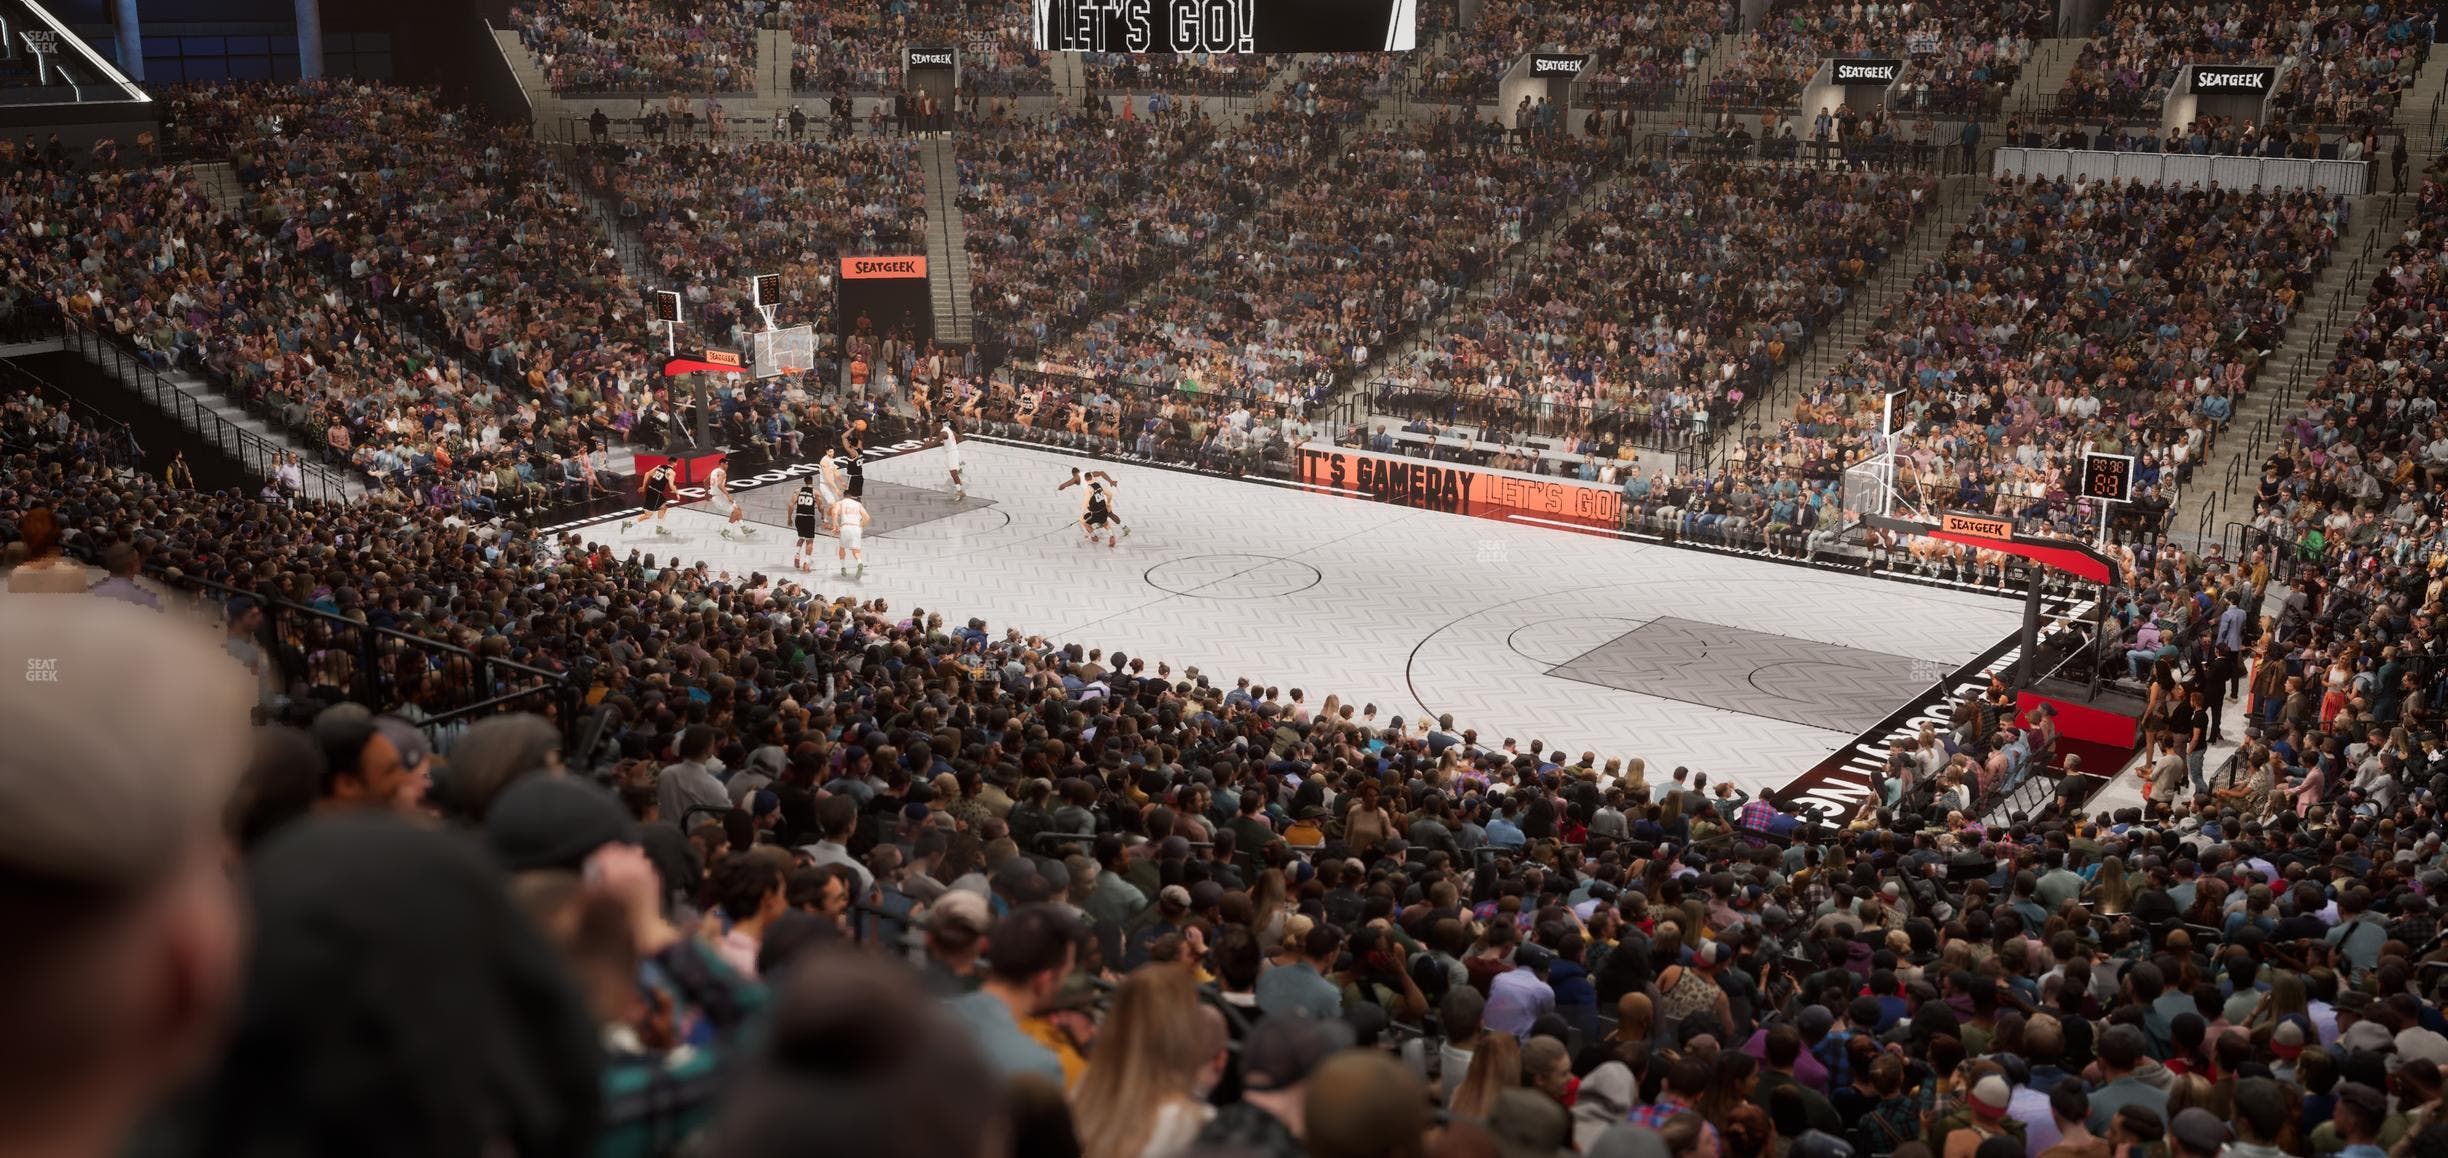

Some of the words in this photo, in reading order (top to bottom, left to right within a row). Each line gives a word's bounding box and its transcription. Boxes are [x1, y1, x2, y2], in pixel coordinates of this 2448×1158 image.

[1060, 0, 1150, 52] LET'S
[1170, 0, 1254, 53] GO!
[911, 53, 951, 65] SEATGEEK
[1536, 59, 1582, 72] SEATGEEK
[1838, 65, 1894, 79] SEATGEEK
[2198, 72, 2264, 88] SEATGEEK
[855, 261, 915, 274] SEATGEEK
[1299, 448, 1345, 482] IT'S
[1356, 457, 1475, 501] GAMEDAY
[1486, 473, 1563, 514] LET'S
[1576, 486, 1622, 522] GO!
[1950, 518, 2003, 536] SEATGEEK
